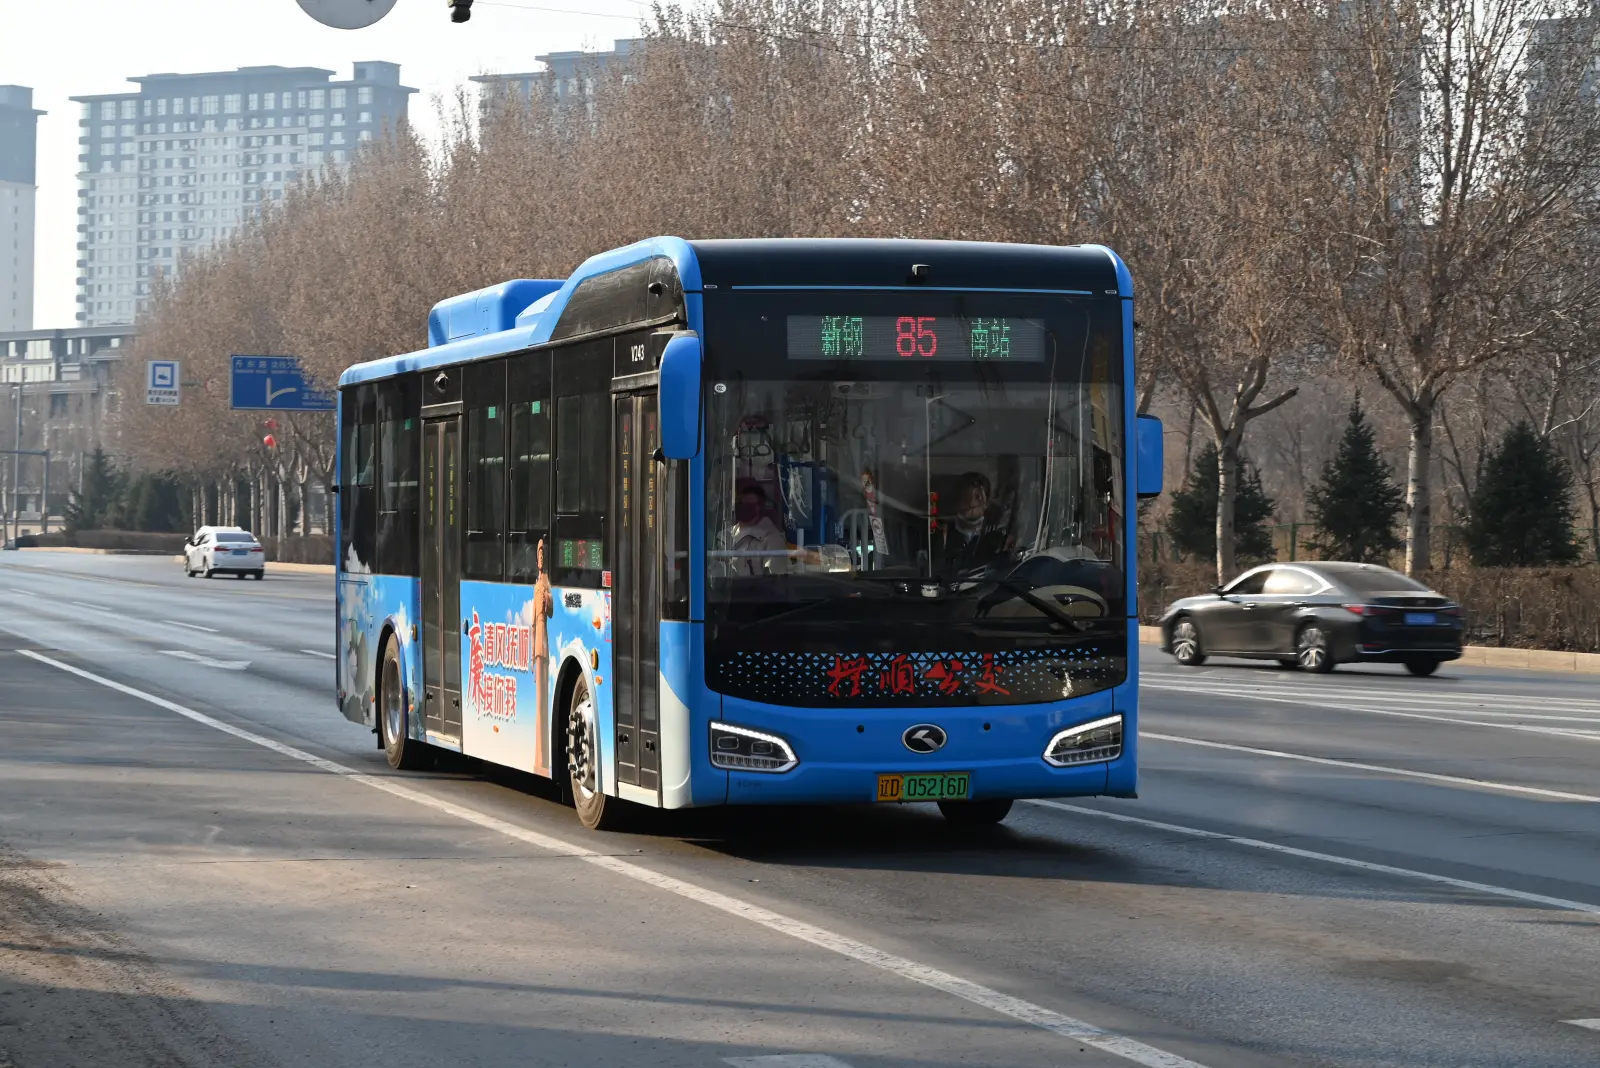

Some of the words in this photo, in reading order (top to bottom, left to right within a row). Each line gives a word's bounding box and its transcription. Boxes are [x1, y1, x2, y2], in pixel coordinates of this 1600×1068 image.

[821, 316, 863, 356] 新钢
[896, 316, 937, 357] 85
[971, 317, 1011, 358] 南站
[484, 623, 529, 668] 清风抚顺
[483, 673, 517, 717] 接你我
[907, 777, 967, 797] 05216D
